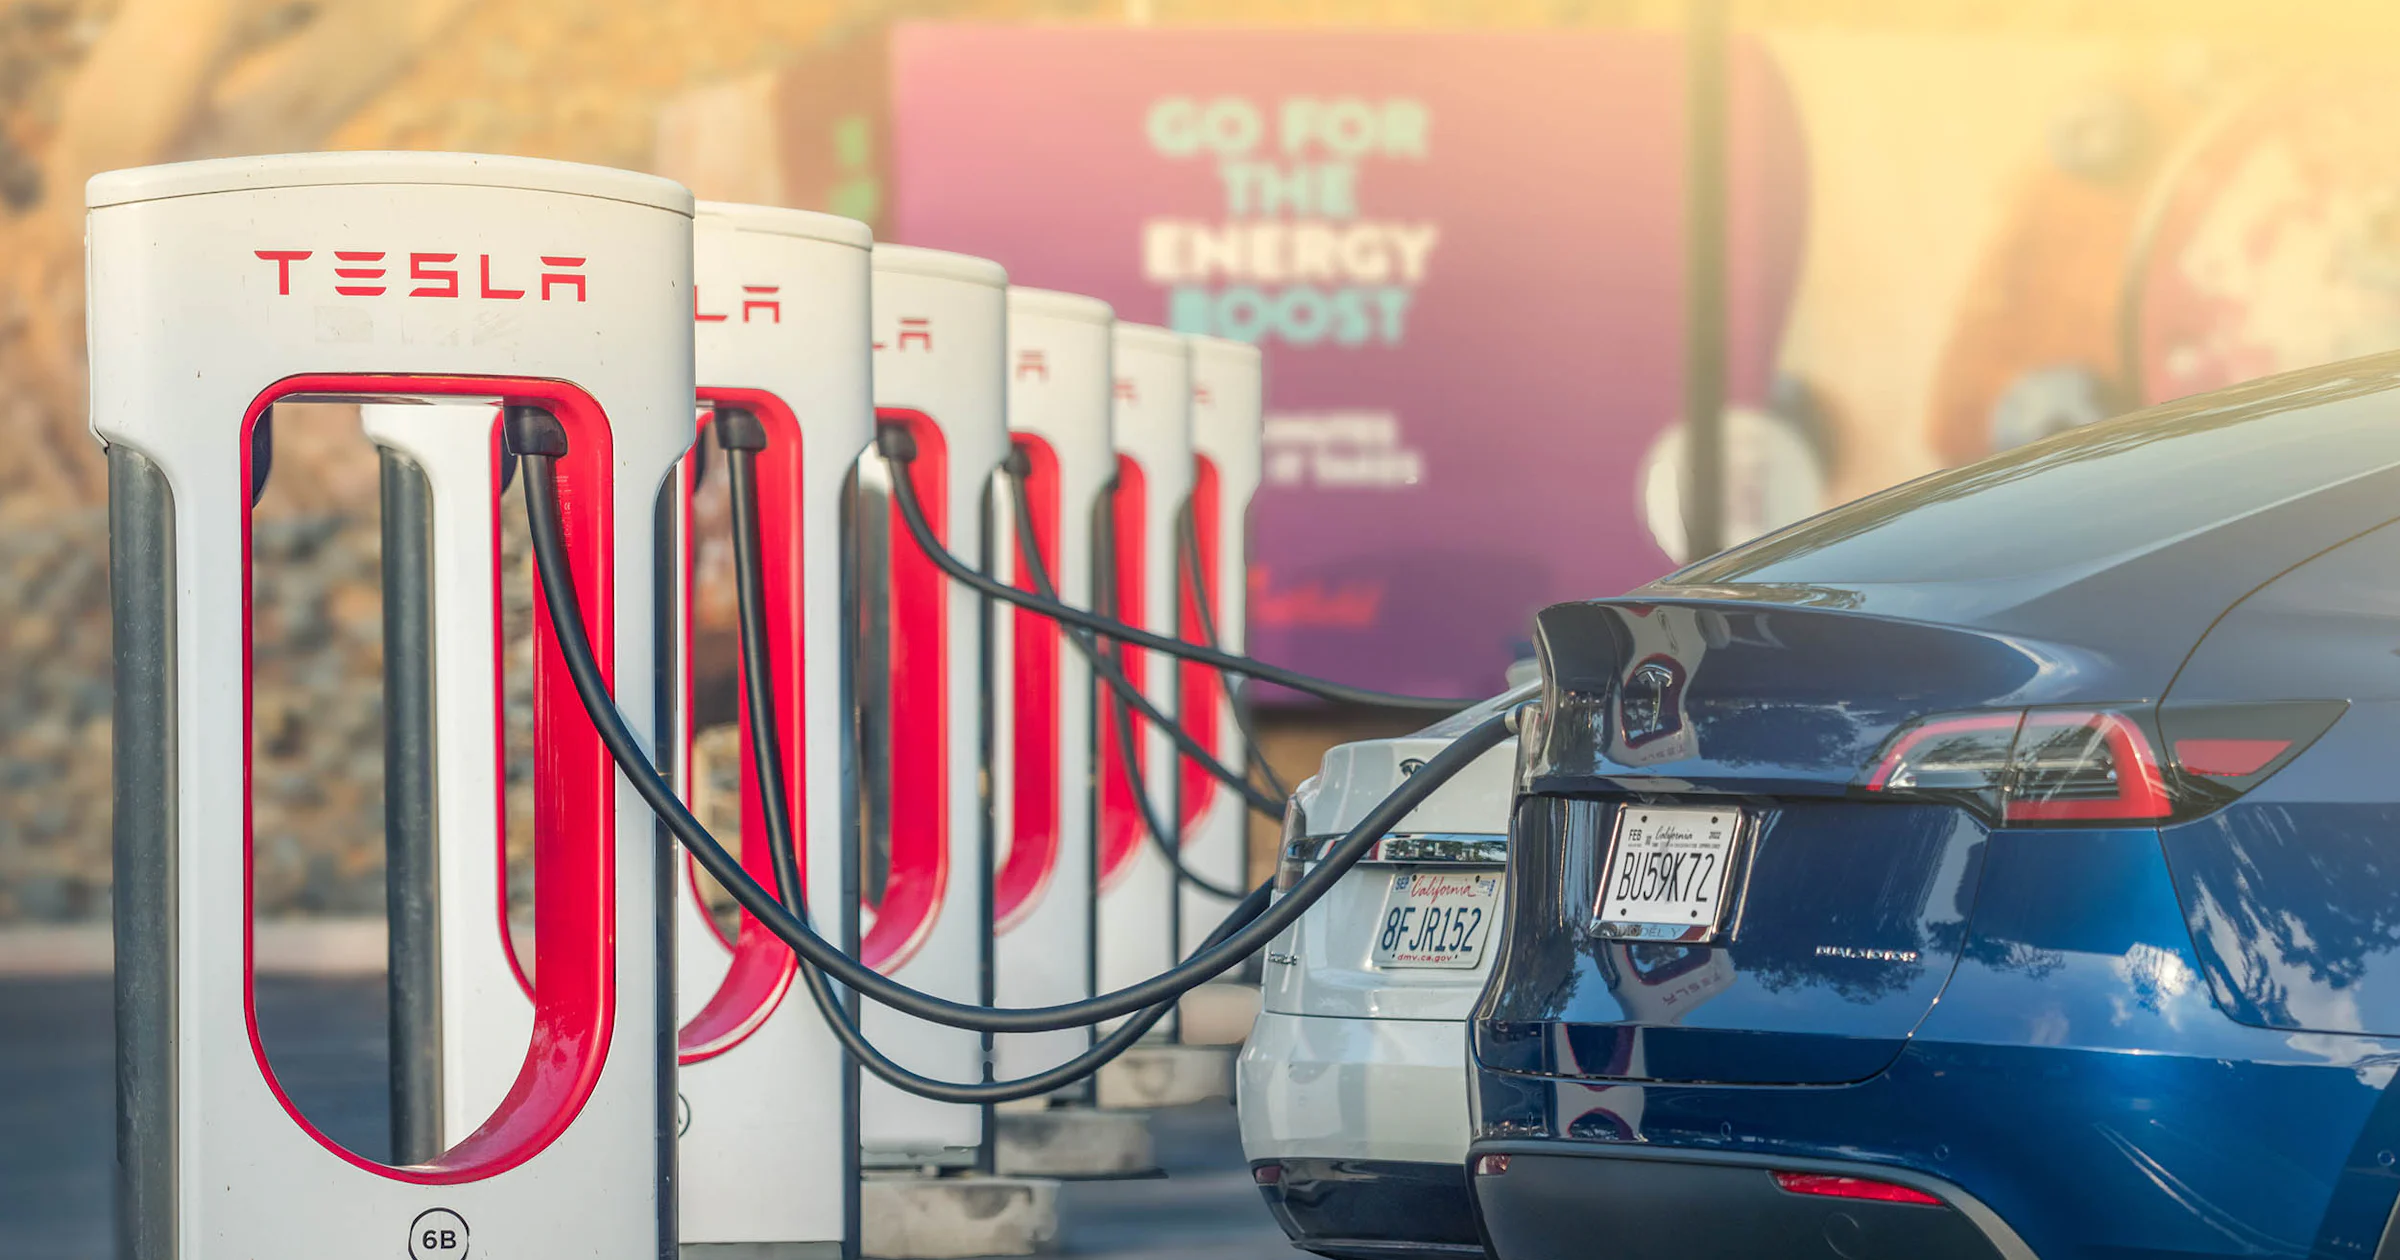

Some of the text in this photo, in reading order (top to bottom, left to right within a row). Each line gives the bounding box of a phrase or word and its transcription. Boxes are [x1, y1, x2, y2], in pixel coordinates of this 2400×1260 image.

[1147, 98, 1429, 157] GO FOR
[1221, 163, 1357, 218] THE
[1143, 222, 1436, 282] ENERGY
[254, 250, 586, 302] TESLA
[1168, 288, 1410, 345] BOOST
[1628, 829, 1642, 841] FEB
[1655, 826, 1693, 848] California
[1395, 877, 1409, 890] SEP
[1411, 875, 1476, 904] California
[1616, 852, 1715, 902] BU59K72
[1382, 907, 1482, 952] 8FJR152
[1398, 954, 1453, 963] dmv.ca.gov
[422, 1229, 457, 1249] 6B
